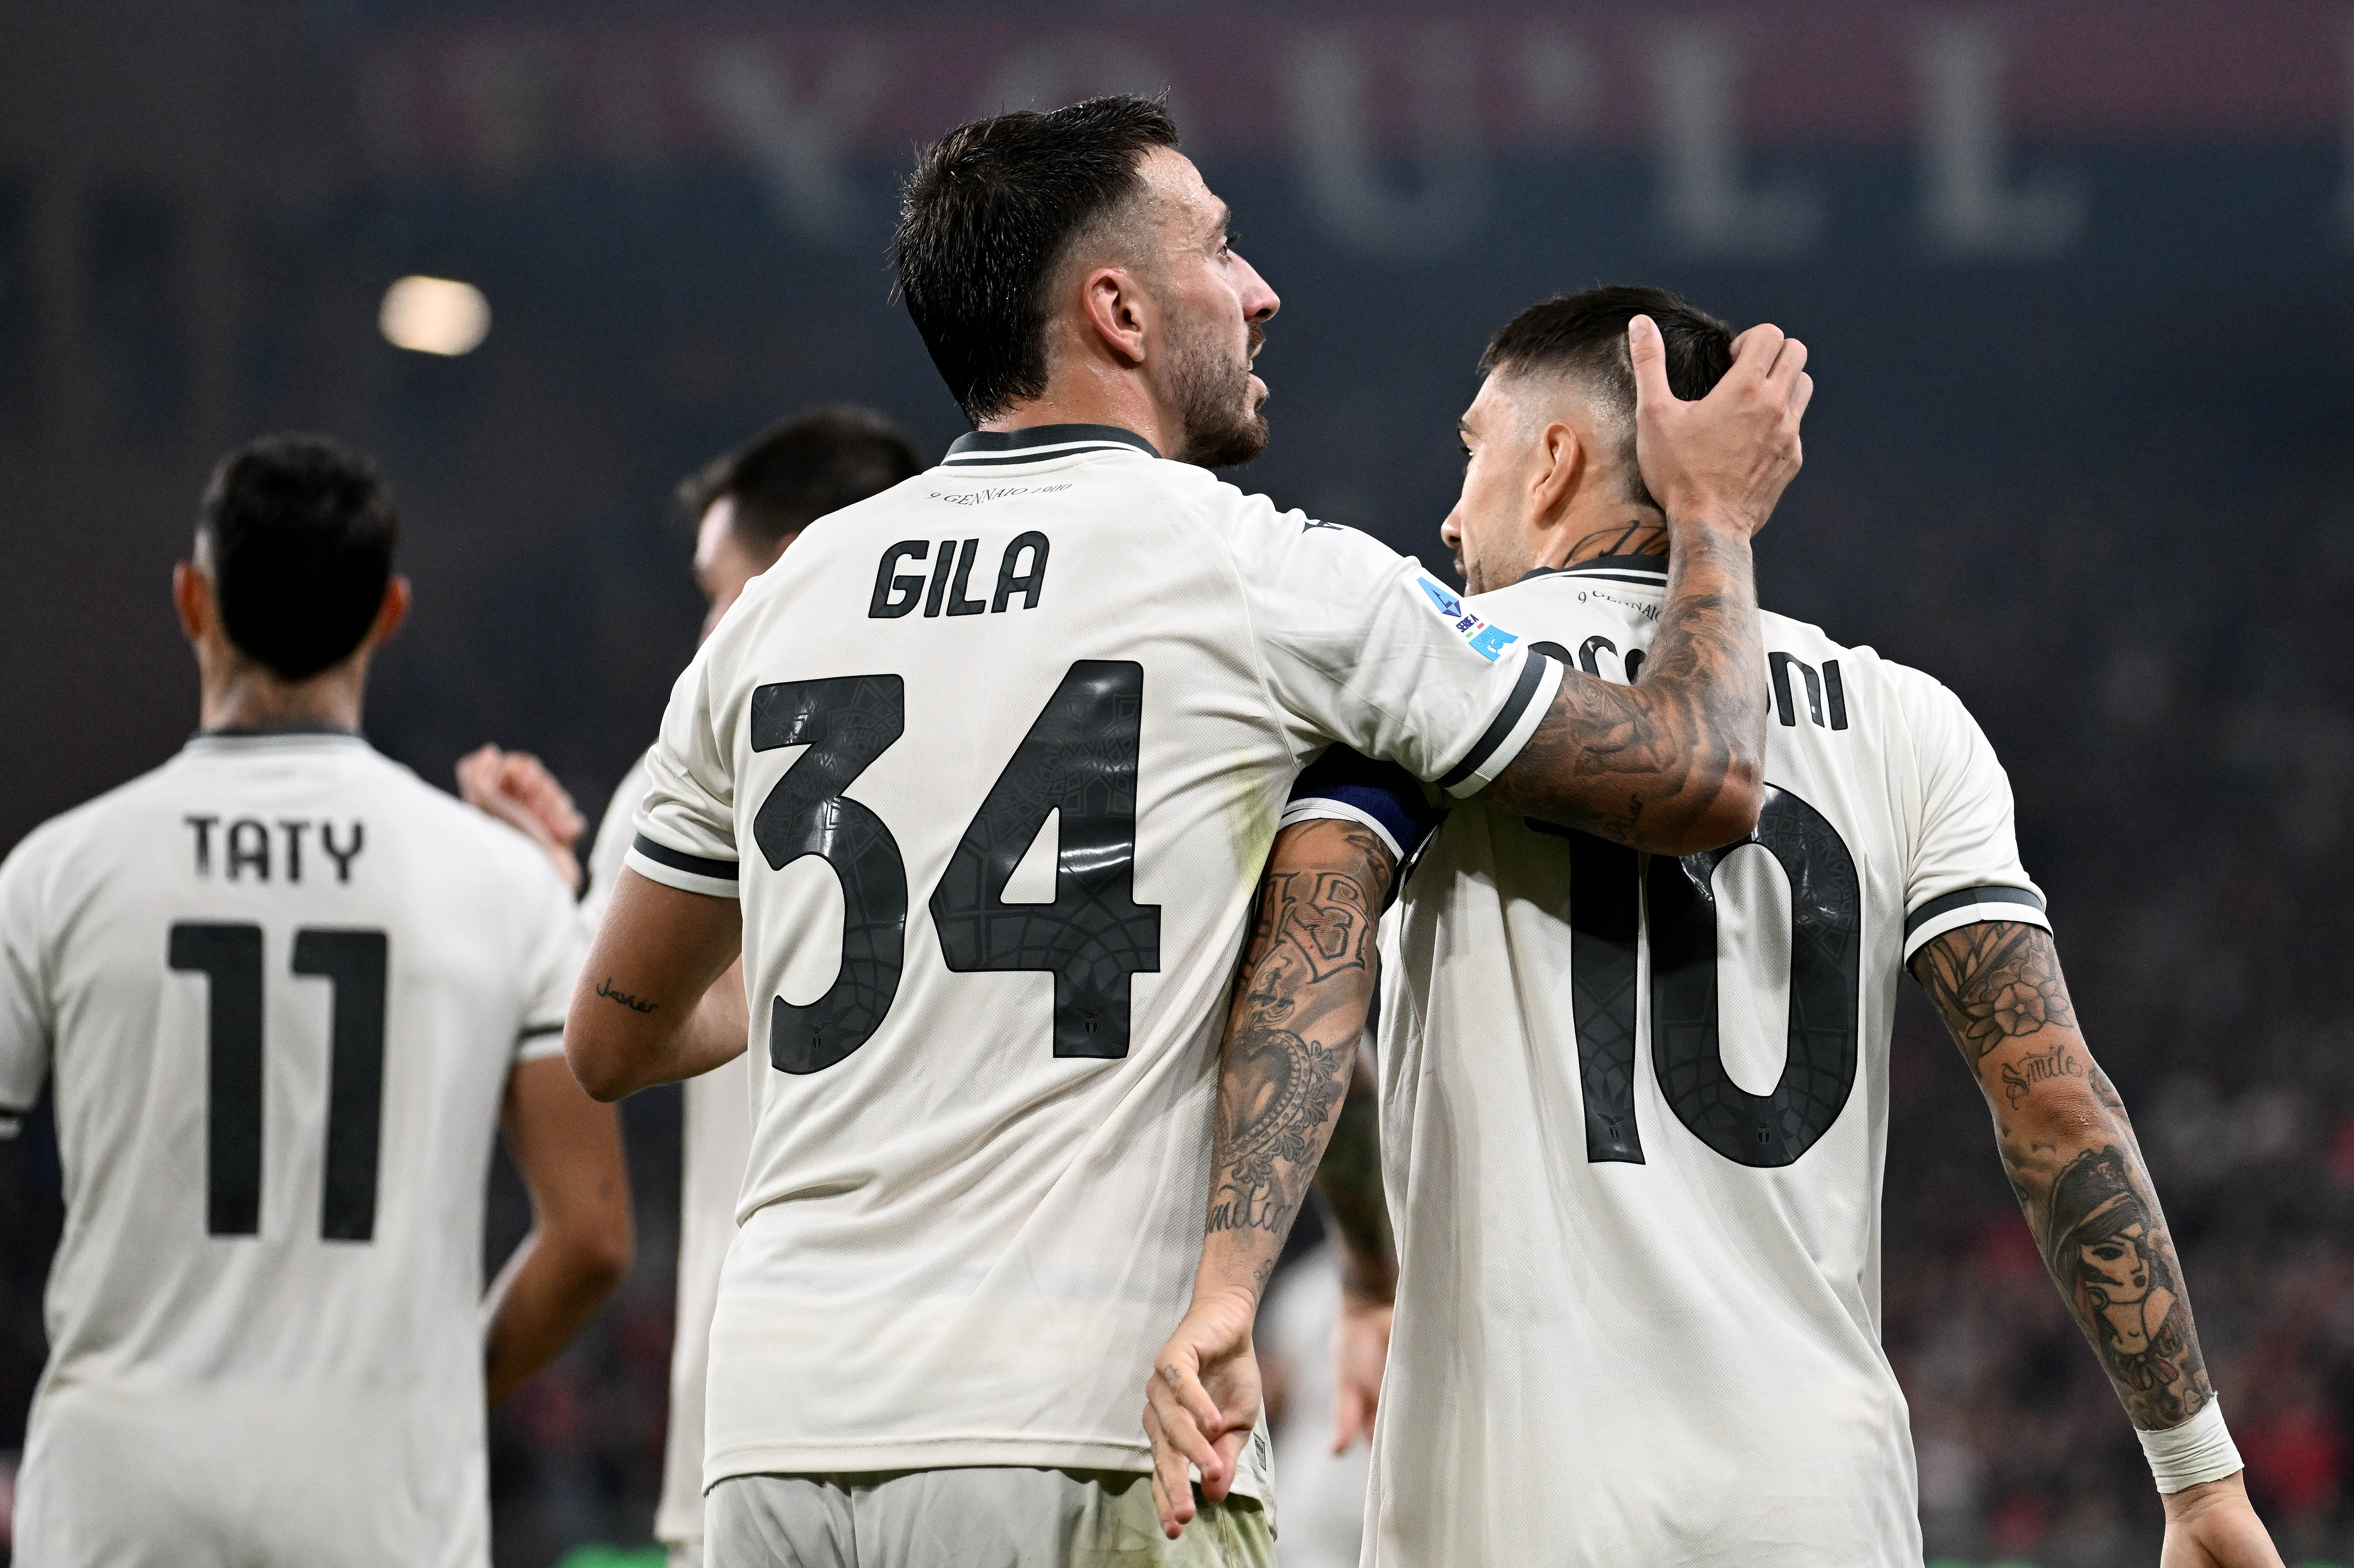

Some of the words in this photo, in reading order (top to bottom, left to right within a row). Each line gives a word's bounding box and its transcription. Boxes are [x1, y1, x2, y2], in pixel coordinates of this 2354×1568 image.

[692, 26, 2091, 261] YU'LL
[943, 488, 1028, 505] GENNAIO
[1029, 484, 1072, 494] 1900
[868, 530, 1050, 619] GILA
[1578, 591, 1587, 604] 9
[1456, 616, 1475, 633] SERIE
[1470, 614, 1479, 623] A
[182, 813, 366, 884] TATY
[750, 660, 1161, 1075] 34
[1524, 781, 1861, 1169] 10
[167, 919, 389, 1243] 11
